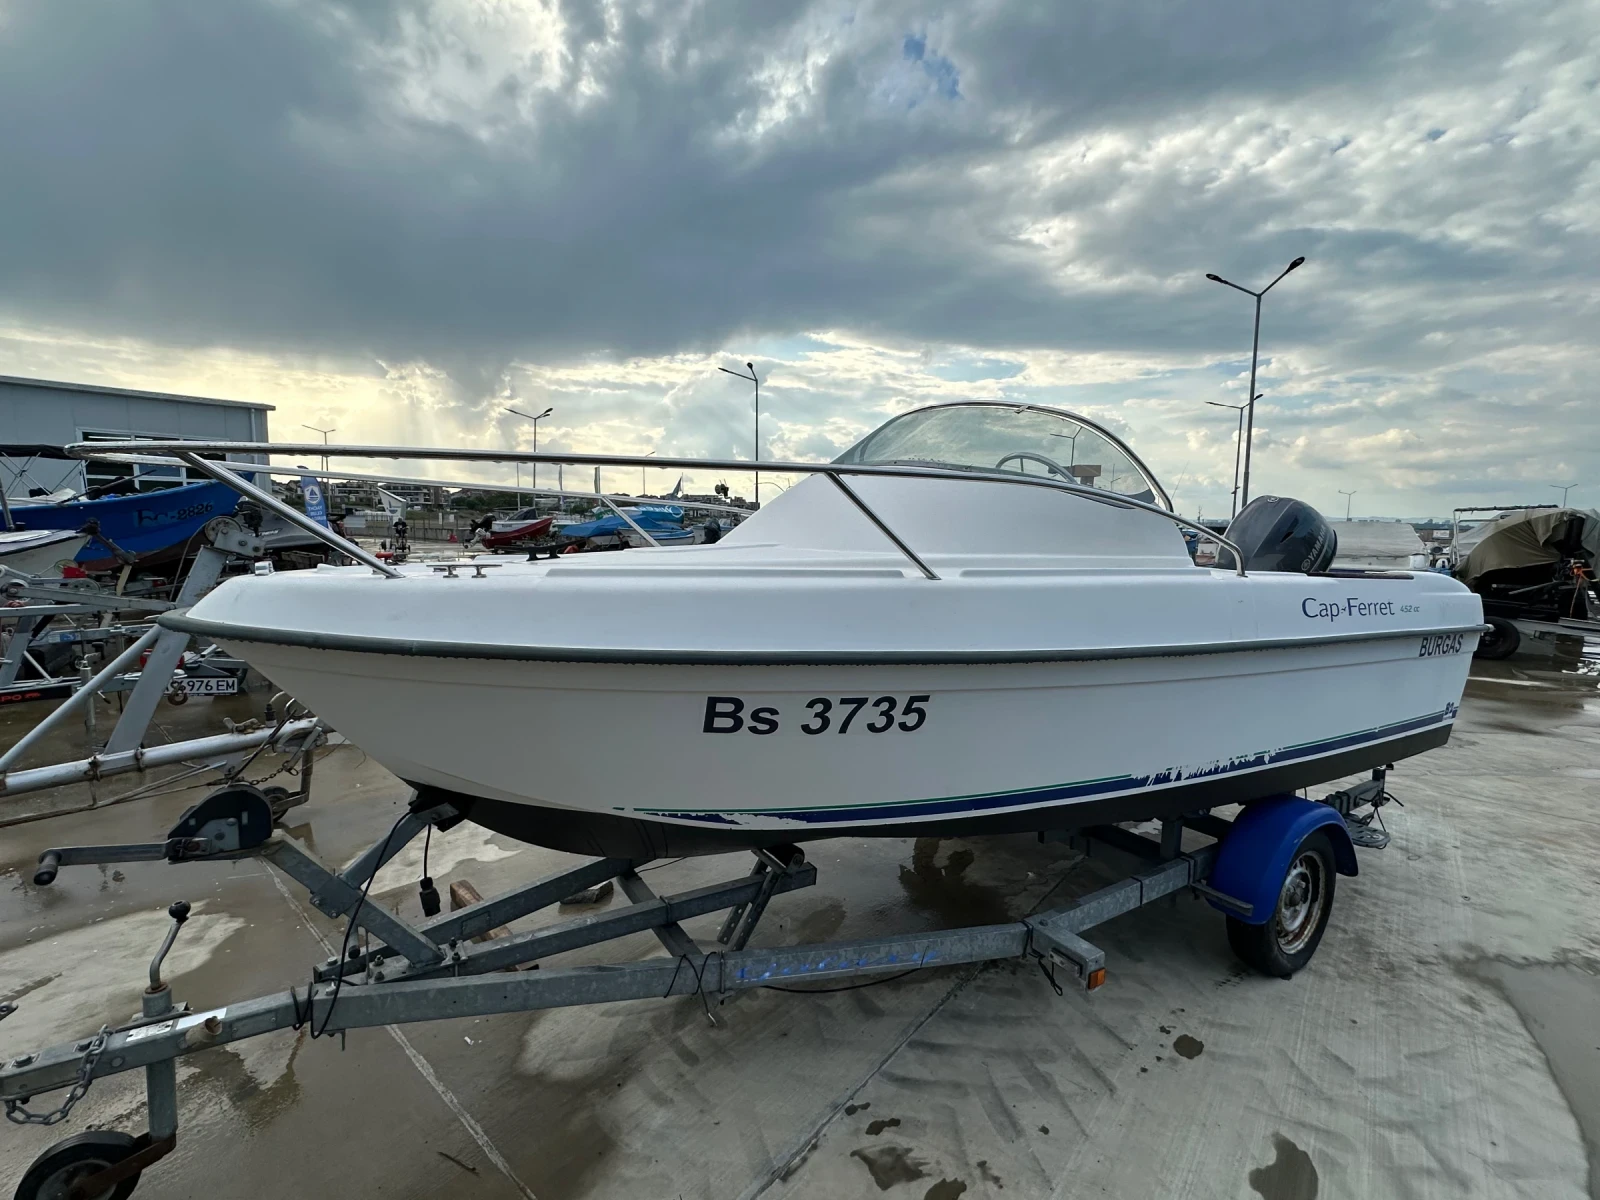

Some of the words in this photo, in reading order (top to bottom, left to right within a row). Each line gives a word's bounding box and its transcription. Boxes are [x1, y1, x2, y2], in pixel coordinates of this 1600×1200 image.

[1400, 605, 1413, 613] 452
[1418, 633, 1464, 657] BURGAS
[216, 680, 235, 691] EM
[702, 696, 780, 735] Bs
[800, 695, 931, 735] 3735
